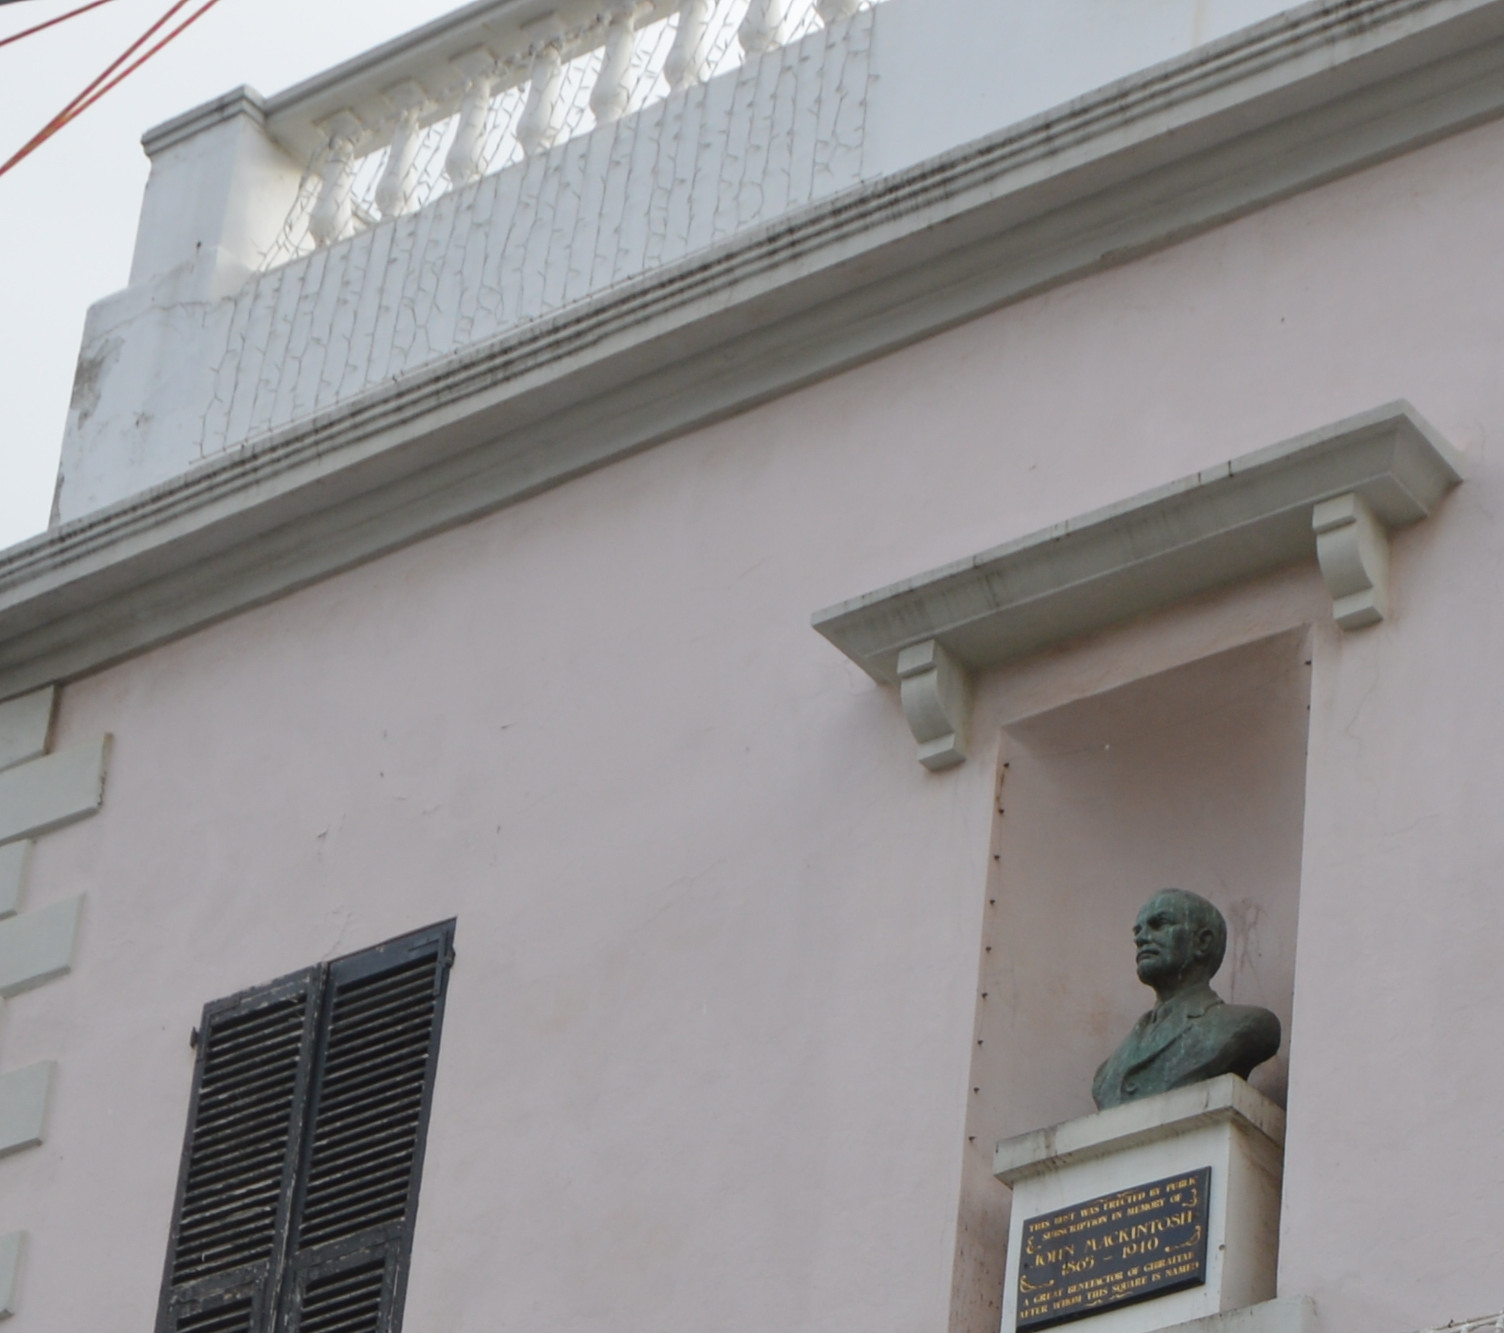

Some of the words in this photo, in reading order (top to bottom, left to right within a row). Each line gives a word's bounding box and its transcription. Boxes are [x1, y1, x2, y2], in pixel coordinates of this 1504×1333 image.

[1029, 1220, 1050, 1233] THIS
[1080, 1205, 1100, 1218] WAS
[1103, 1191, 1146, 1211] ERECTED
[1149, 1187, 1160, 1197] BY
[1043, 1215, 1108, 1241] SUBSCRIPTION
[1111, 1211, 1122, 1221] IN
[1127, 1198, 1165, 1216] MEMORY
[1169, 1193, 1182, 1204] OF
[1031, 1245, 1075, 1269] JOHN
[1085, 1210, 1193, 1254] MACKINTOSH
[1122, 1237, 1159, 1259] 1940
[1020, 1304, 1048, 1319] AFTER
[1053, 1295, 1082, 1309] WHOM
[1087, 1288, 1108, 1301] THIS
[1112, 1276, 1148, 1293] SQUARE
[1151, 1272, 1161, 1282] IS
[1165, 1261, 1199, 1277] NAMED
[1033, 1288, 1063, 1303] GREAT
[1067, 1271, 1124, 1295] BENEFACTOR
[1127, 1266, 1140, 1277] OF
[1143, 1251, 1195, 1272] GIBRALTAR
